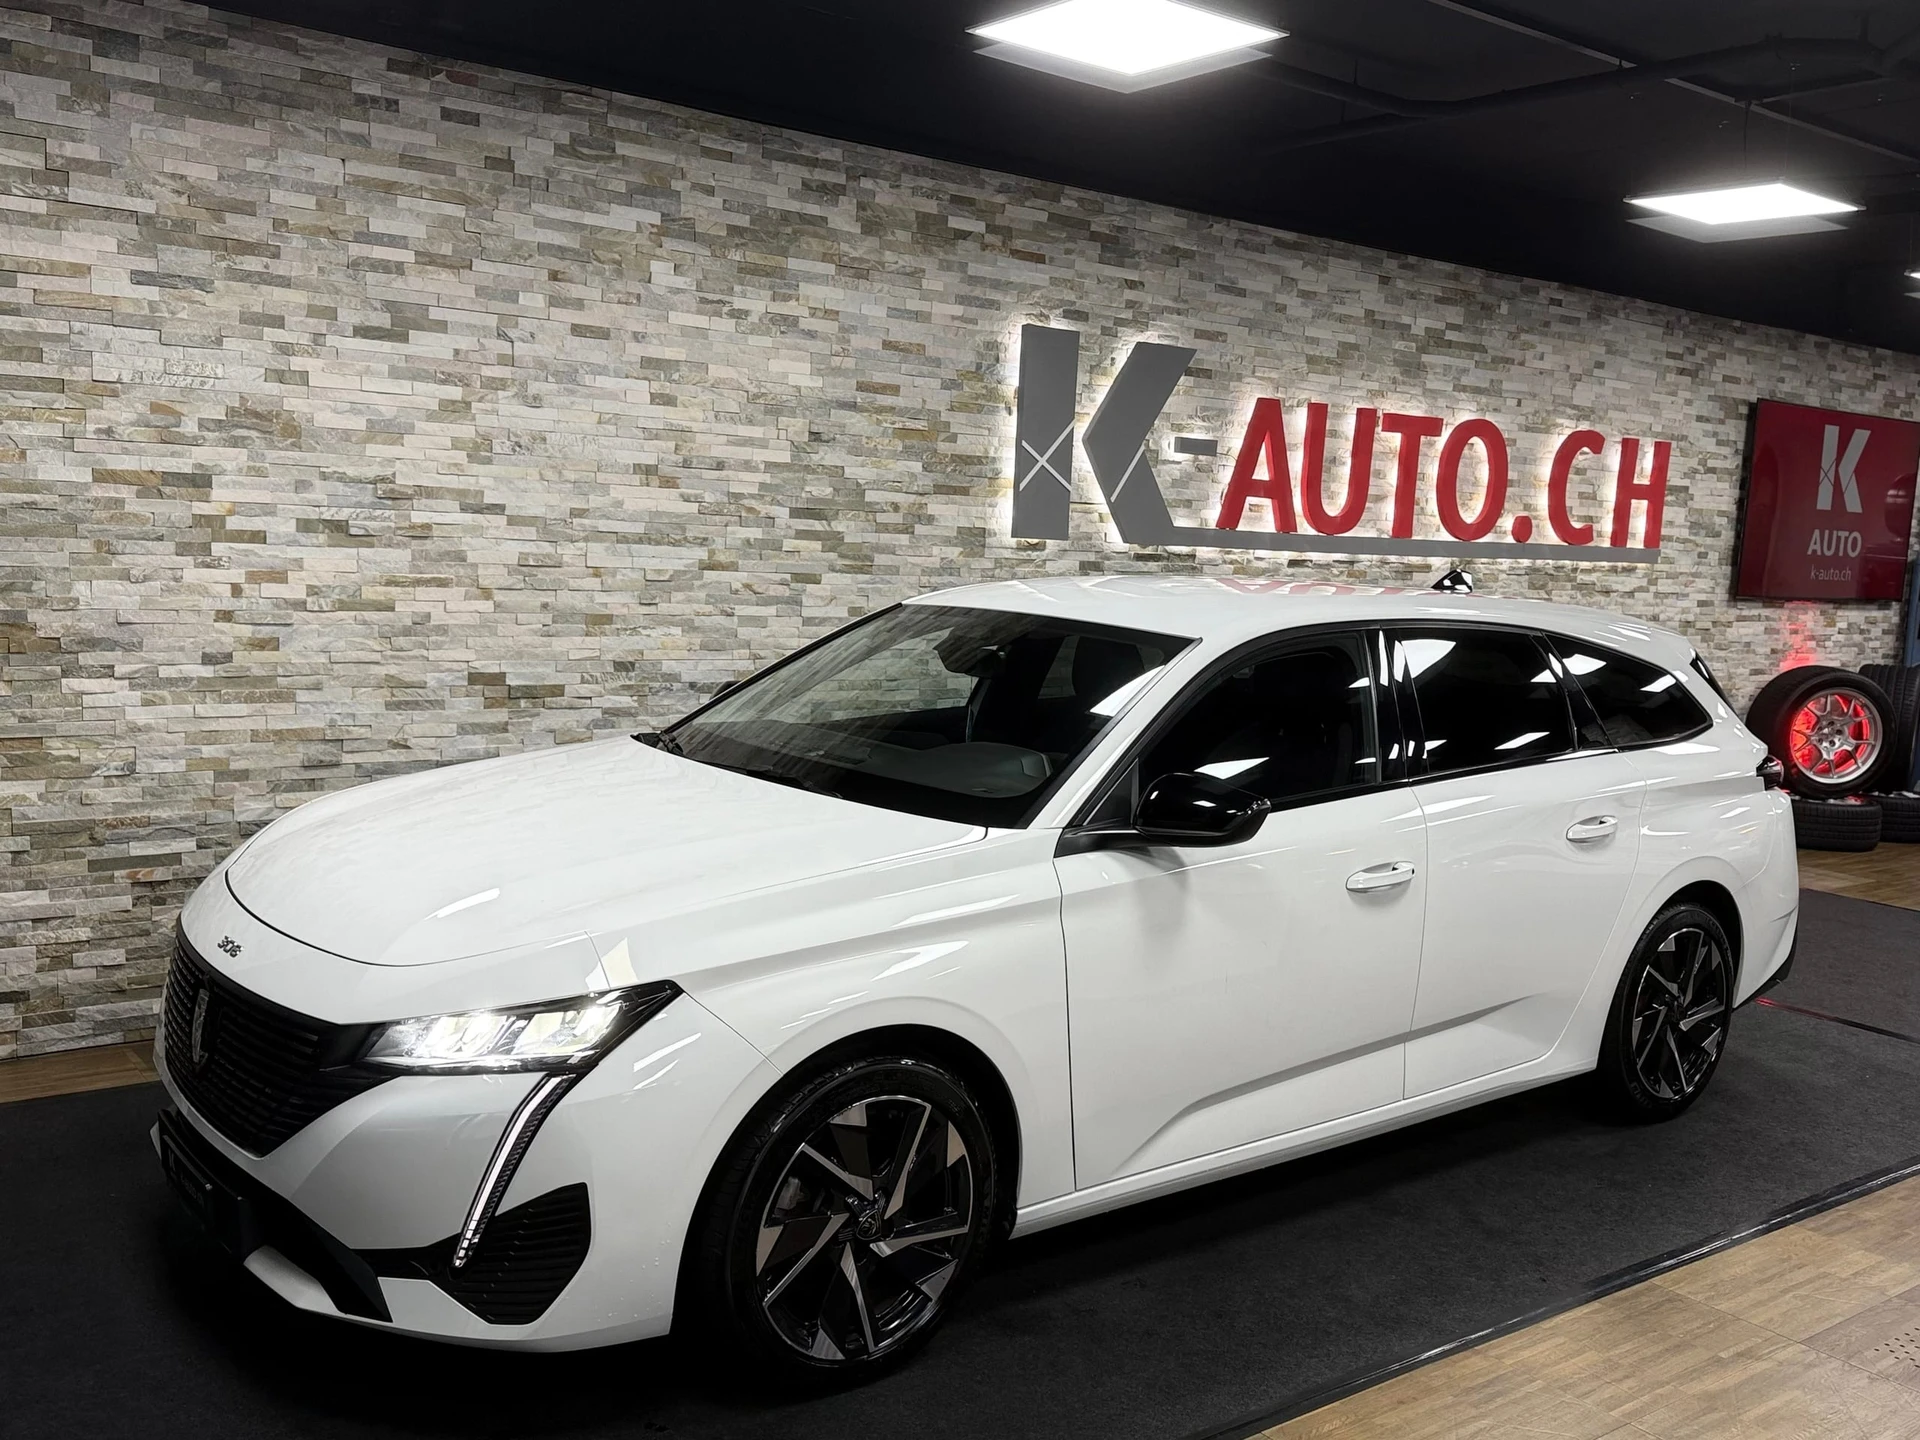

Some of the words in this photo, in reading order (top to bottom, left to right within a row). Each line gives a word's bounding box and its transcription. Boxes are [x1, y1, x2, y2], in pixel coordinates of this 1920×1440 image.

[1011, 323, 1671, 549] K-AUTO.CH
[1816, 424, 1871, 513] K
[1807, 529, 1862, 558] AUTO
[1810, 564, 1852, 582] k-auto.ch
